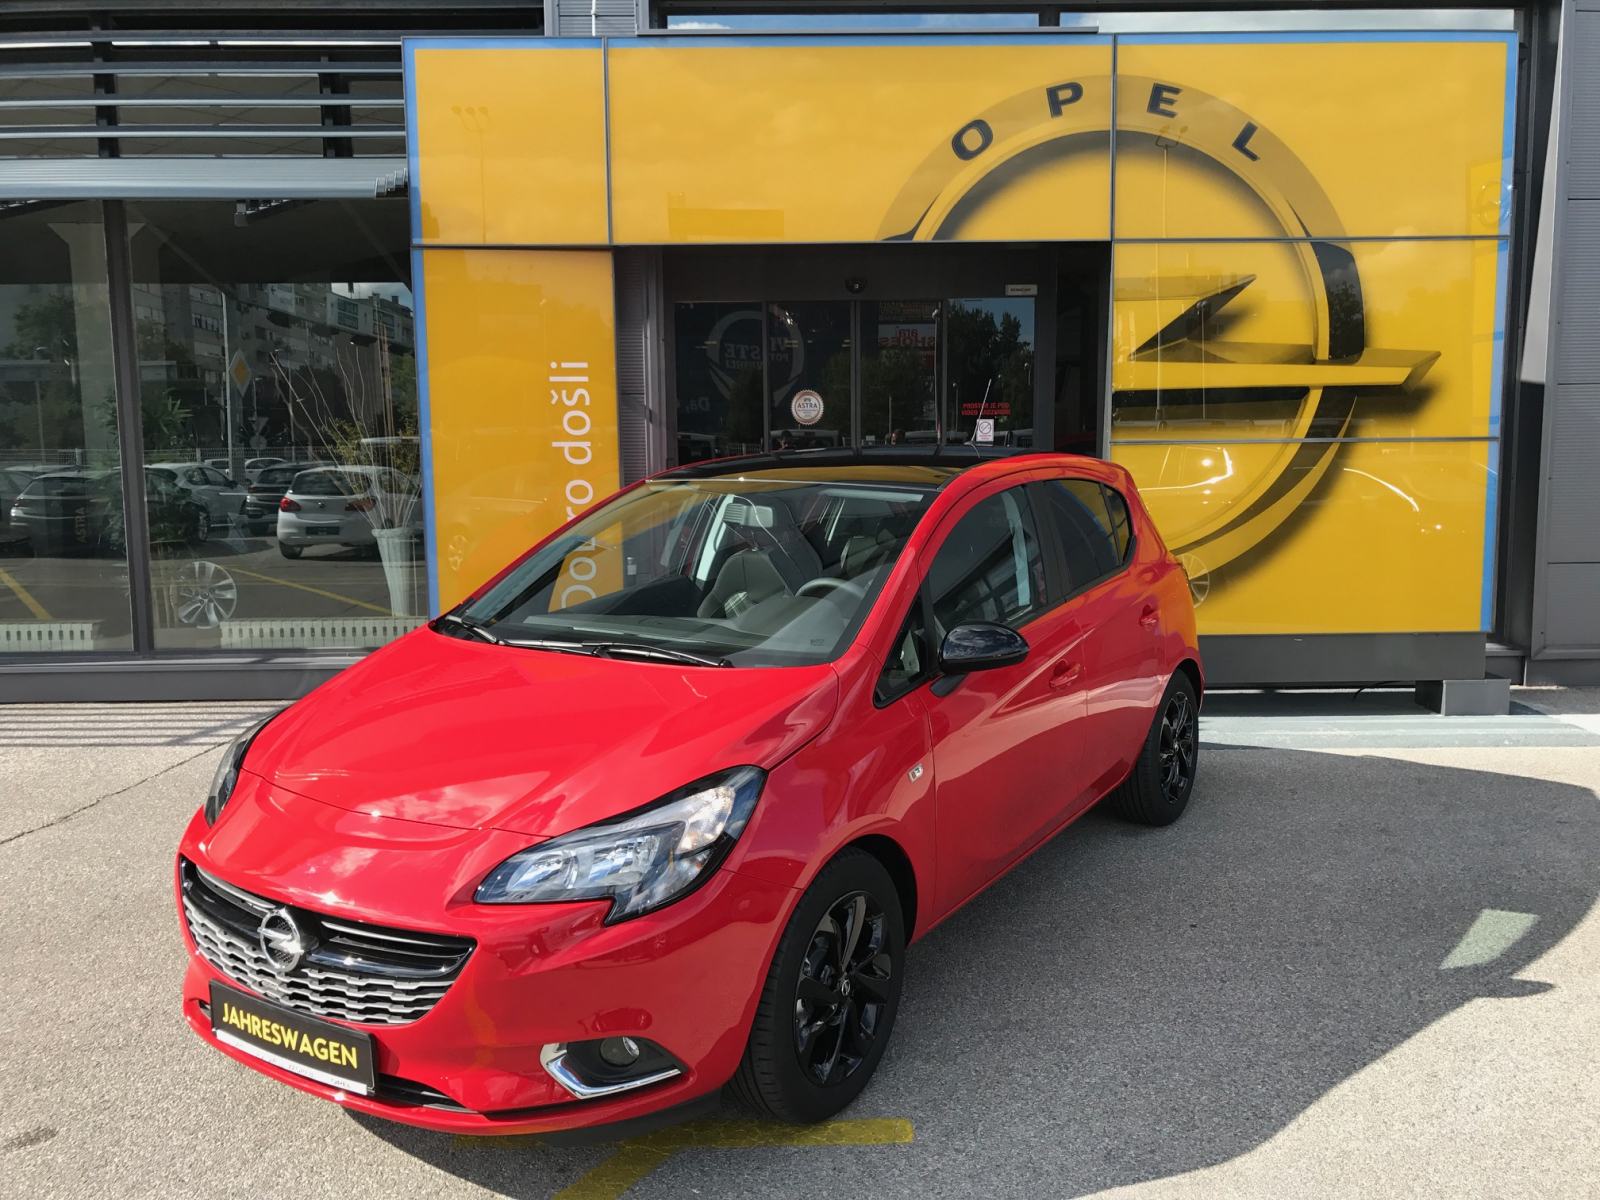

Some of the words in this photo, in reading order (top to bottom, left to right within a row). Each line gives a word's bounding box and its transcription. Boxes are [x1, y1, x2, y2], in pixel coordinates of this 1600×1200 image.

[951, 81, 1260, 161] OPEL
[549, 361, 593, 465] došli
[222, 1003, 358, 1069] JAHRESWAGEN
